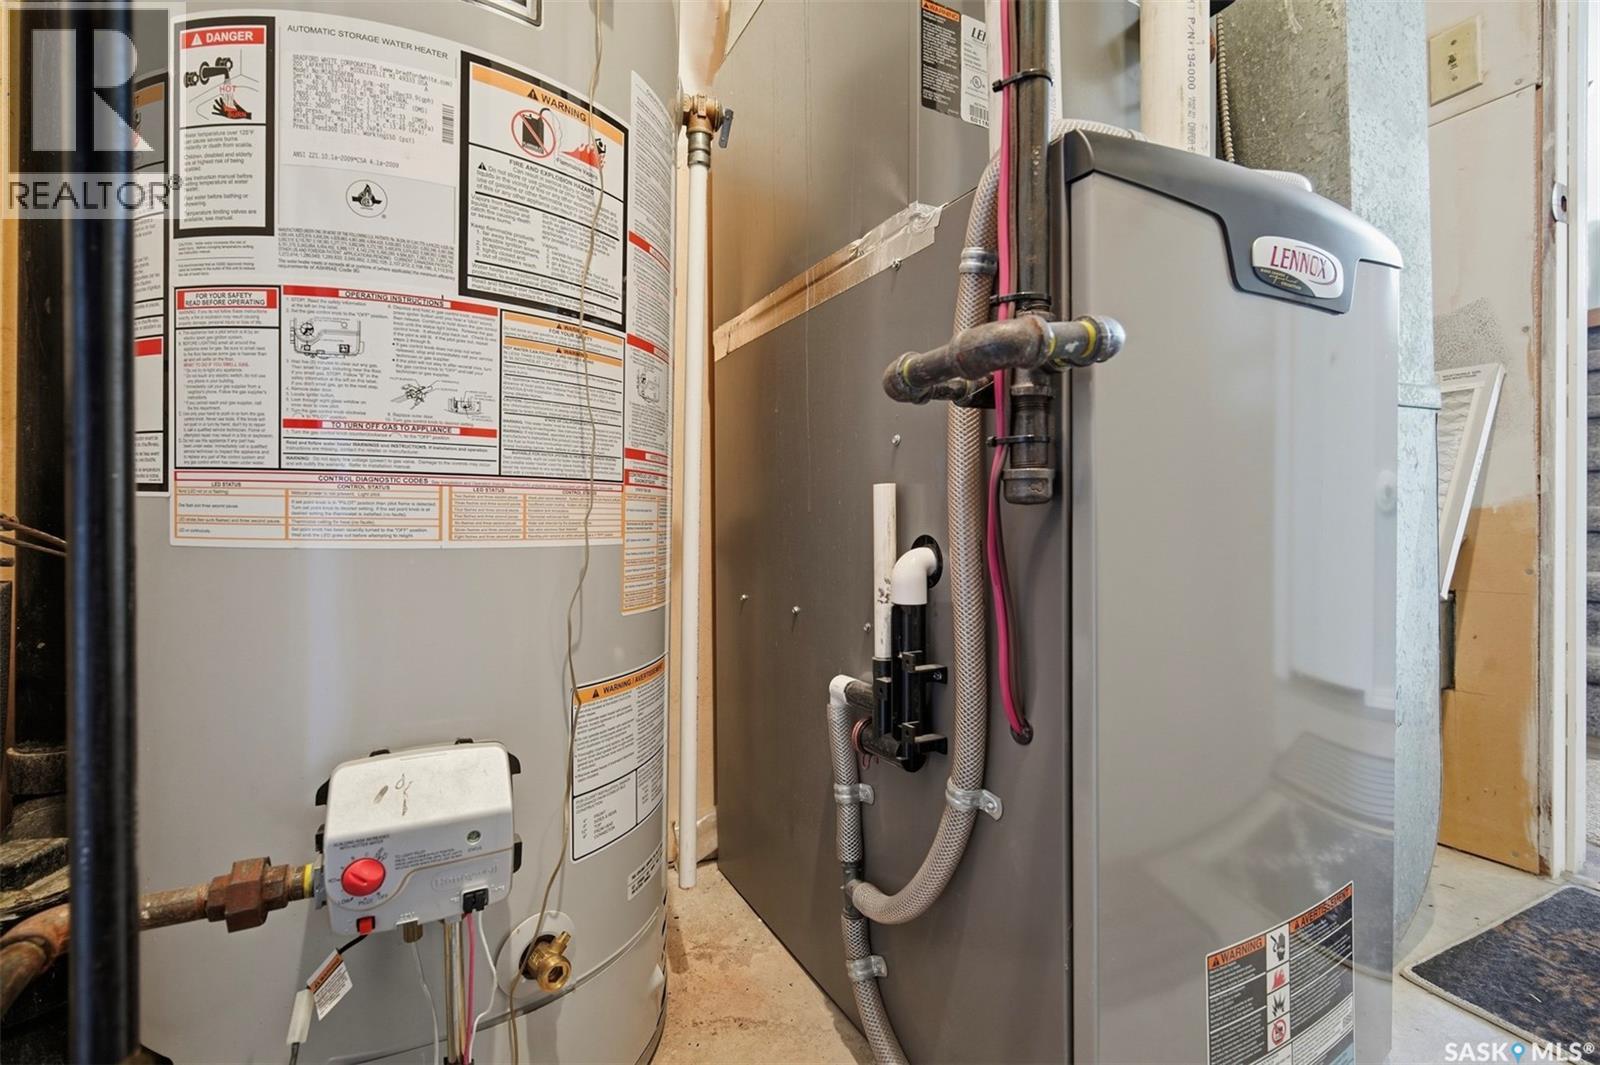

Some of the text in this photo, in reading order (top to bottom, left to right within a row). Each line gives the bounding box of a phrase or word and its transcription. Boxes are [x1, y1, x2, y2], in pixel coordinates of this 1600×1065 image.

[206, 31, 254, 43] DANGER
[287, 24, 449, 60] AUTOMATIC STORAGE WATER HEATER
[219, 85, 237, 93] HOT
[541, 93, 587, 122] WARNING
[1270, 246, 1327, 279] LENNOX
[345, 291, 444, 308] OPERATING INSTRUCTIONS
[332, 421, 452, 434] TO TURN OFF GAS TO APPLIANCE
[318, 475, 352, 484] CONTROL
[355, 476, 402, 485] DIAGNOSTIC
[603, 679, 631, 694] WARNING
[1221, 938, 1263, 963] WARNING
